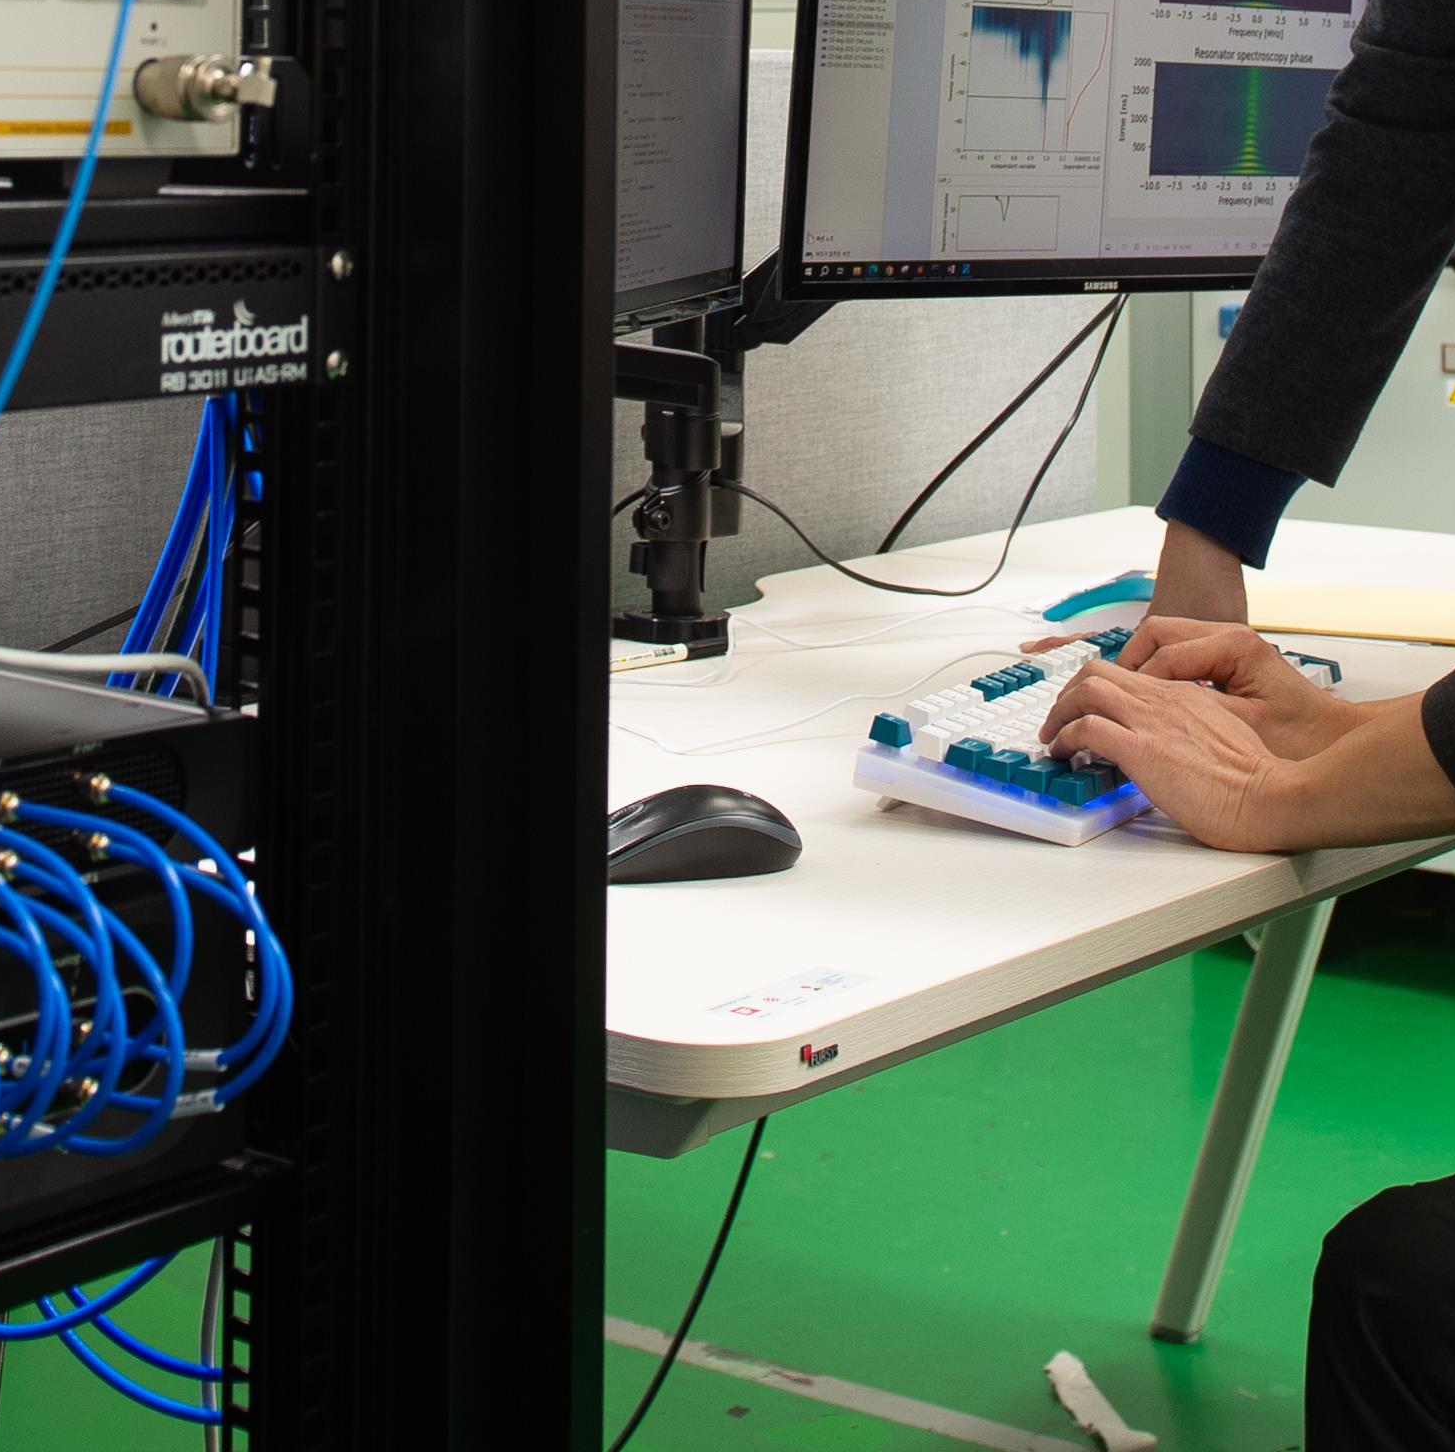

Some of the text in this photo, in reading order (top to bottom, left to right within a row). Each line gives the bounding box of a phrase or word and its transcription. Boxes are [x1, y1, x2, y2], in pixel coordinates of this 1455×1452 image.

[1252, 14, 1262, 24] 0.0
[1275, 16, 1286, 25] 2.5
[1298, 17, 1309, 26] 5.0
[1322, 18, 1332, 27] 7.5
[1229, 27, 1284, 40] Frequency [MHz]
[1195, 48, 1313, 64] Resonator spectroscopy phase
[1134, 58, 1152, 67] 2000
[1132, 86, 1150, 95] 1500
[1130, 114, 1148, 123] 1000
[1132, 142, 1146, 152] 500
[1242, 181, 1252, 191] 0.0
[1265, 181, 1276, 191] 2.5
[1218, 195, 1274, 206] Frequency [MHz]
[1084, 281, 1119, 291] SAMSUNG
[161, 314, 309, 364] routerboard
[161, 371, 186, 393] RB
[188, 368, 227, 390] 3011
[811, 1043, 839, 1067] FURSYS
